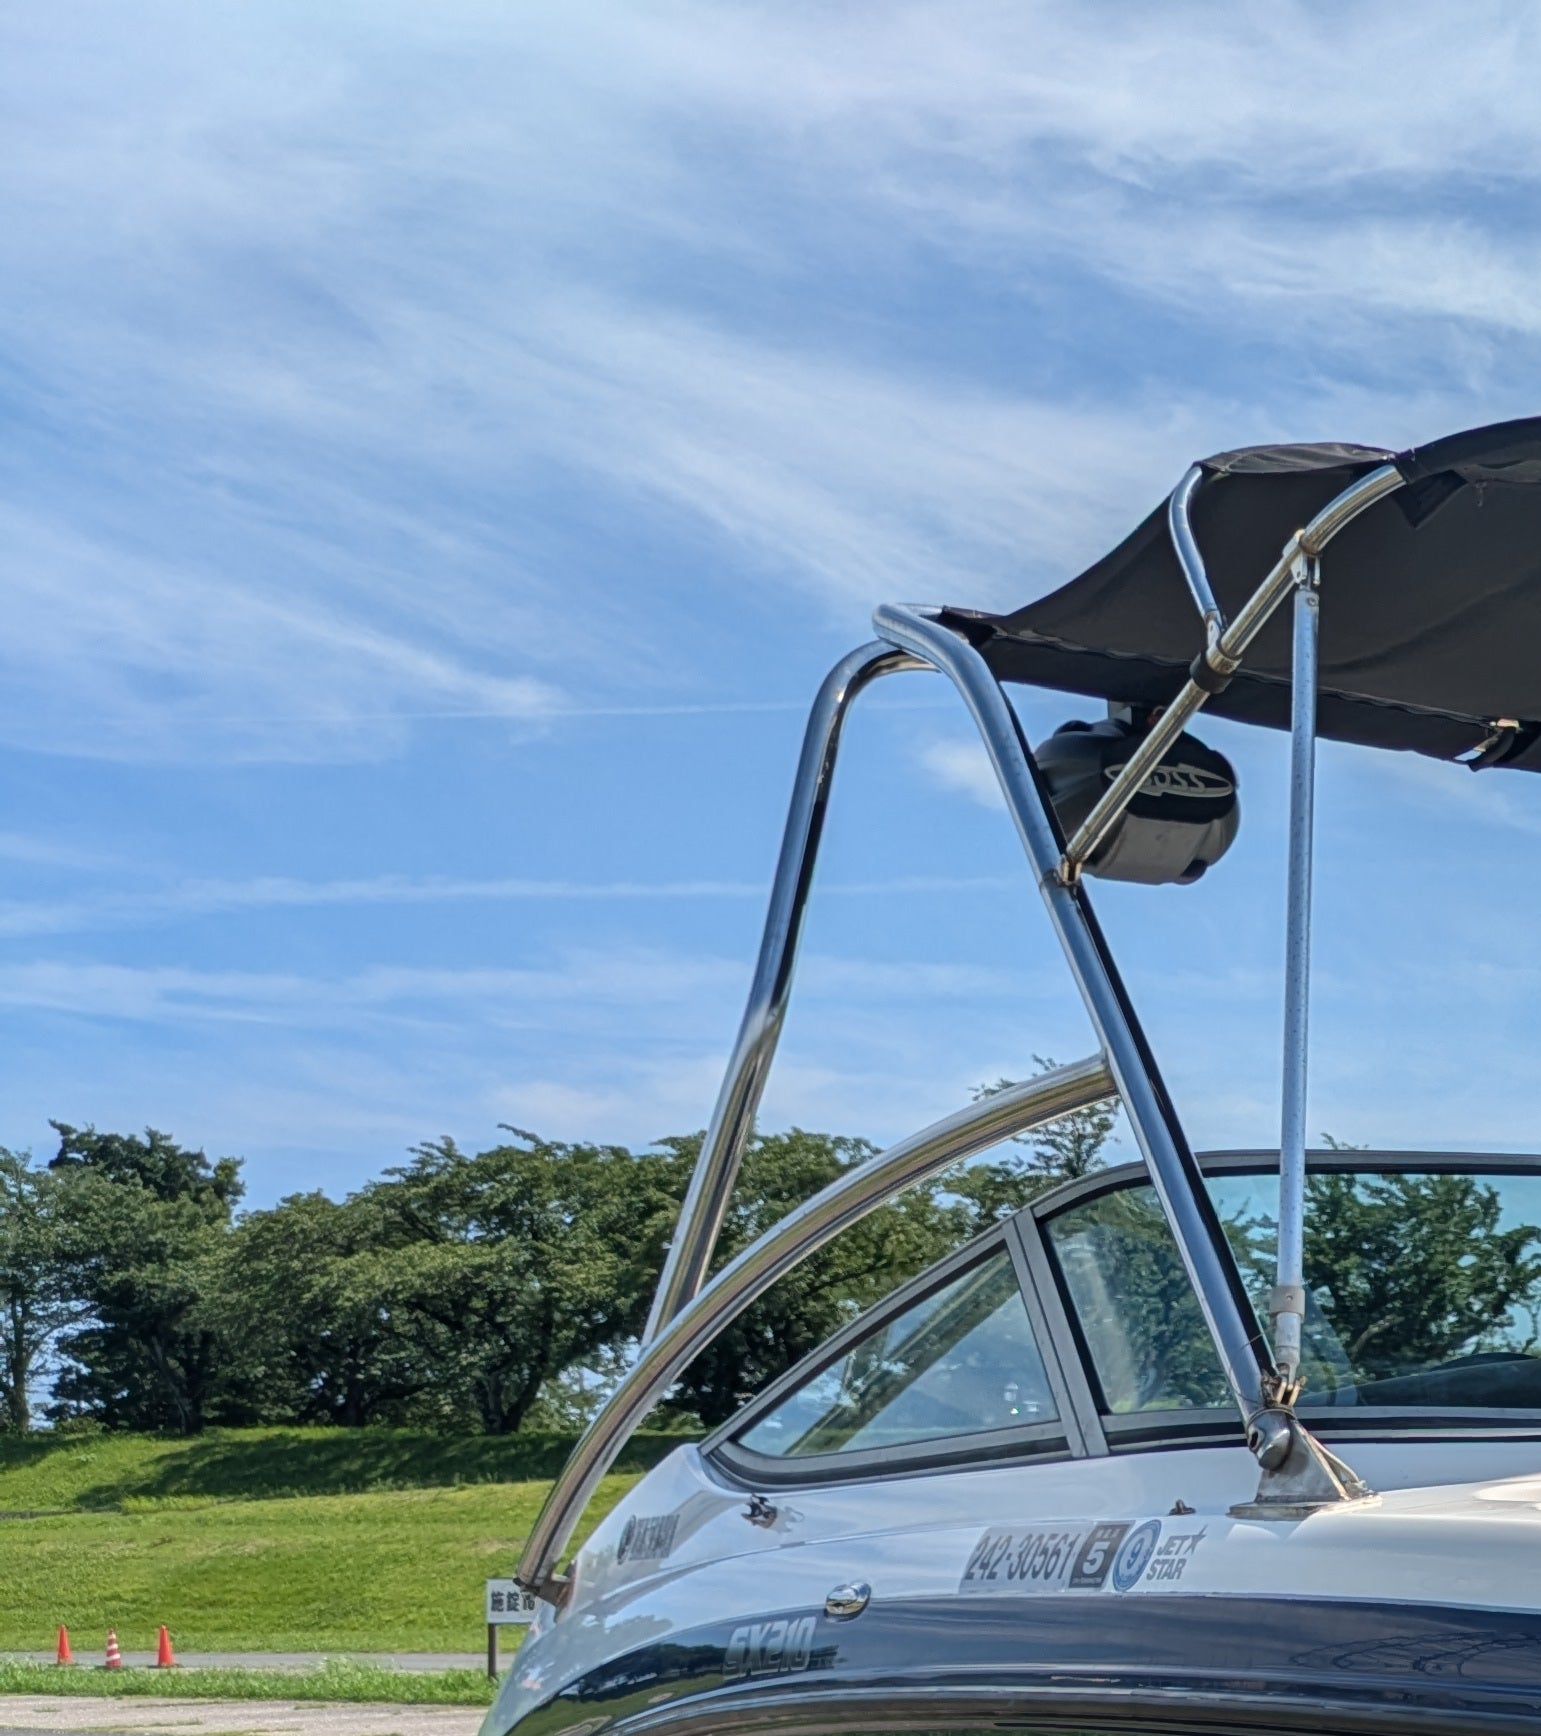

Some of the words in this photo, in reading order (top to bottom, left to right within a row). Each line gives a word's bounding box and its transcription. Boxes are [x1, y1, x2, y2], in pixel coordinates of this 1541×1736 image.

[963, 1533, 1083, 1581] 242-30561
[1145, 1557, 1188, 1581] STAR
[722, 1615, 818, 1677] SX210
